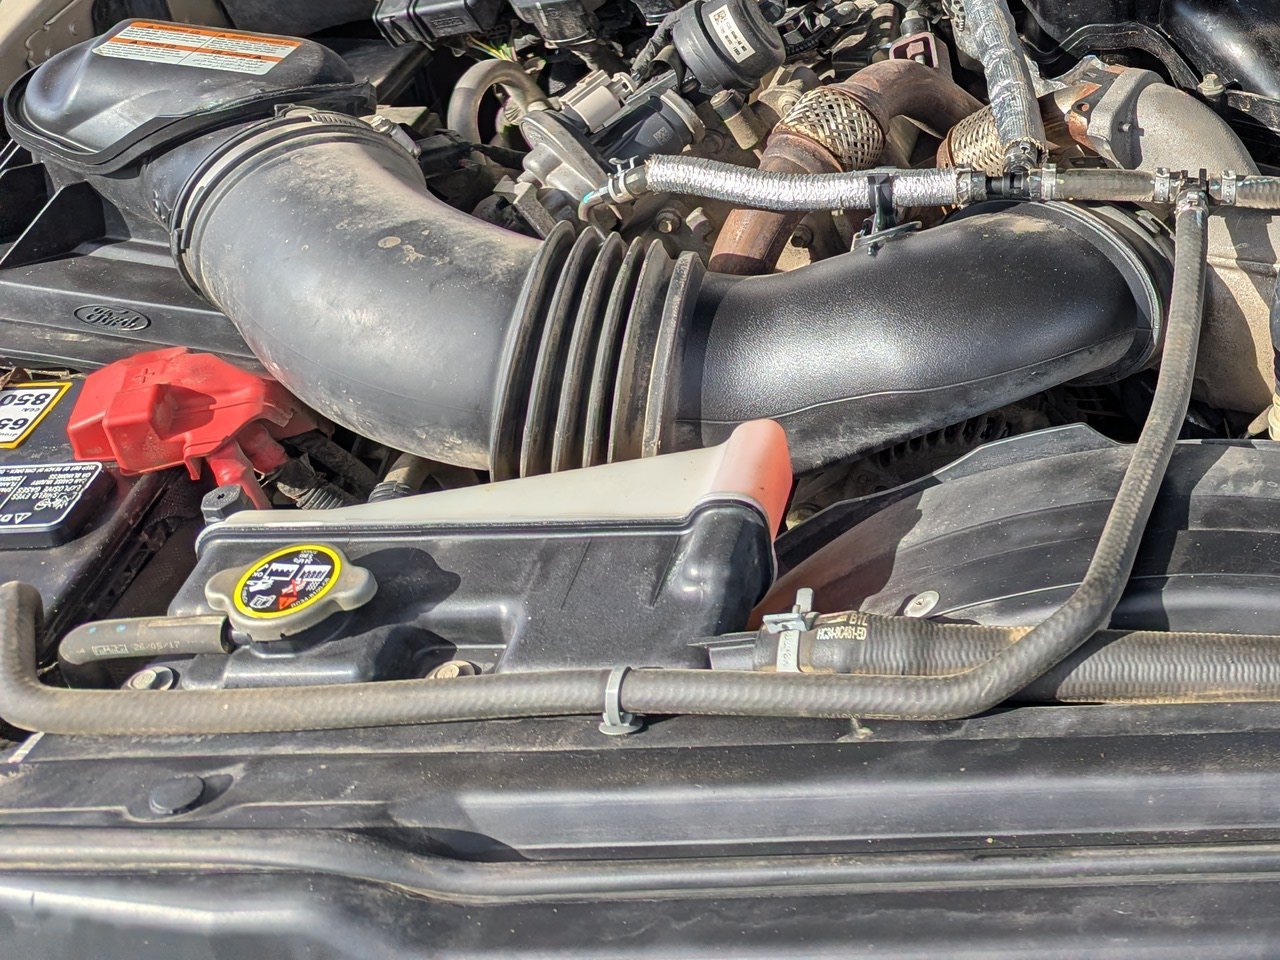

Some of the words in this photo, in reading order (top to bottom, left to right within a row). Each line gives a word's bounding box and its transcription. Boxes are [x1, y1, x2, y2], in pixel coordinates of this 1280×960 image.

[84, 306, 141, 329] Ford
[0, 394, 51, 406] 850
[32, 492, 59, 500] SHIELD
